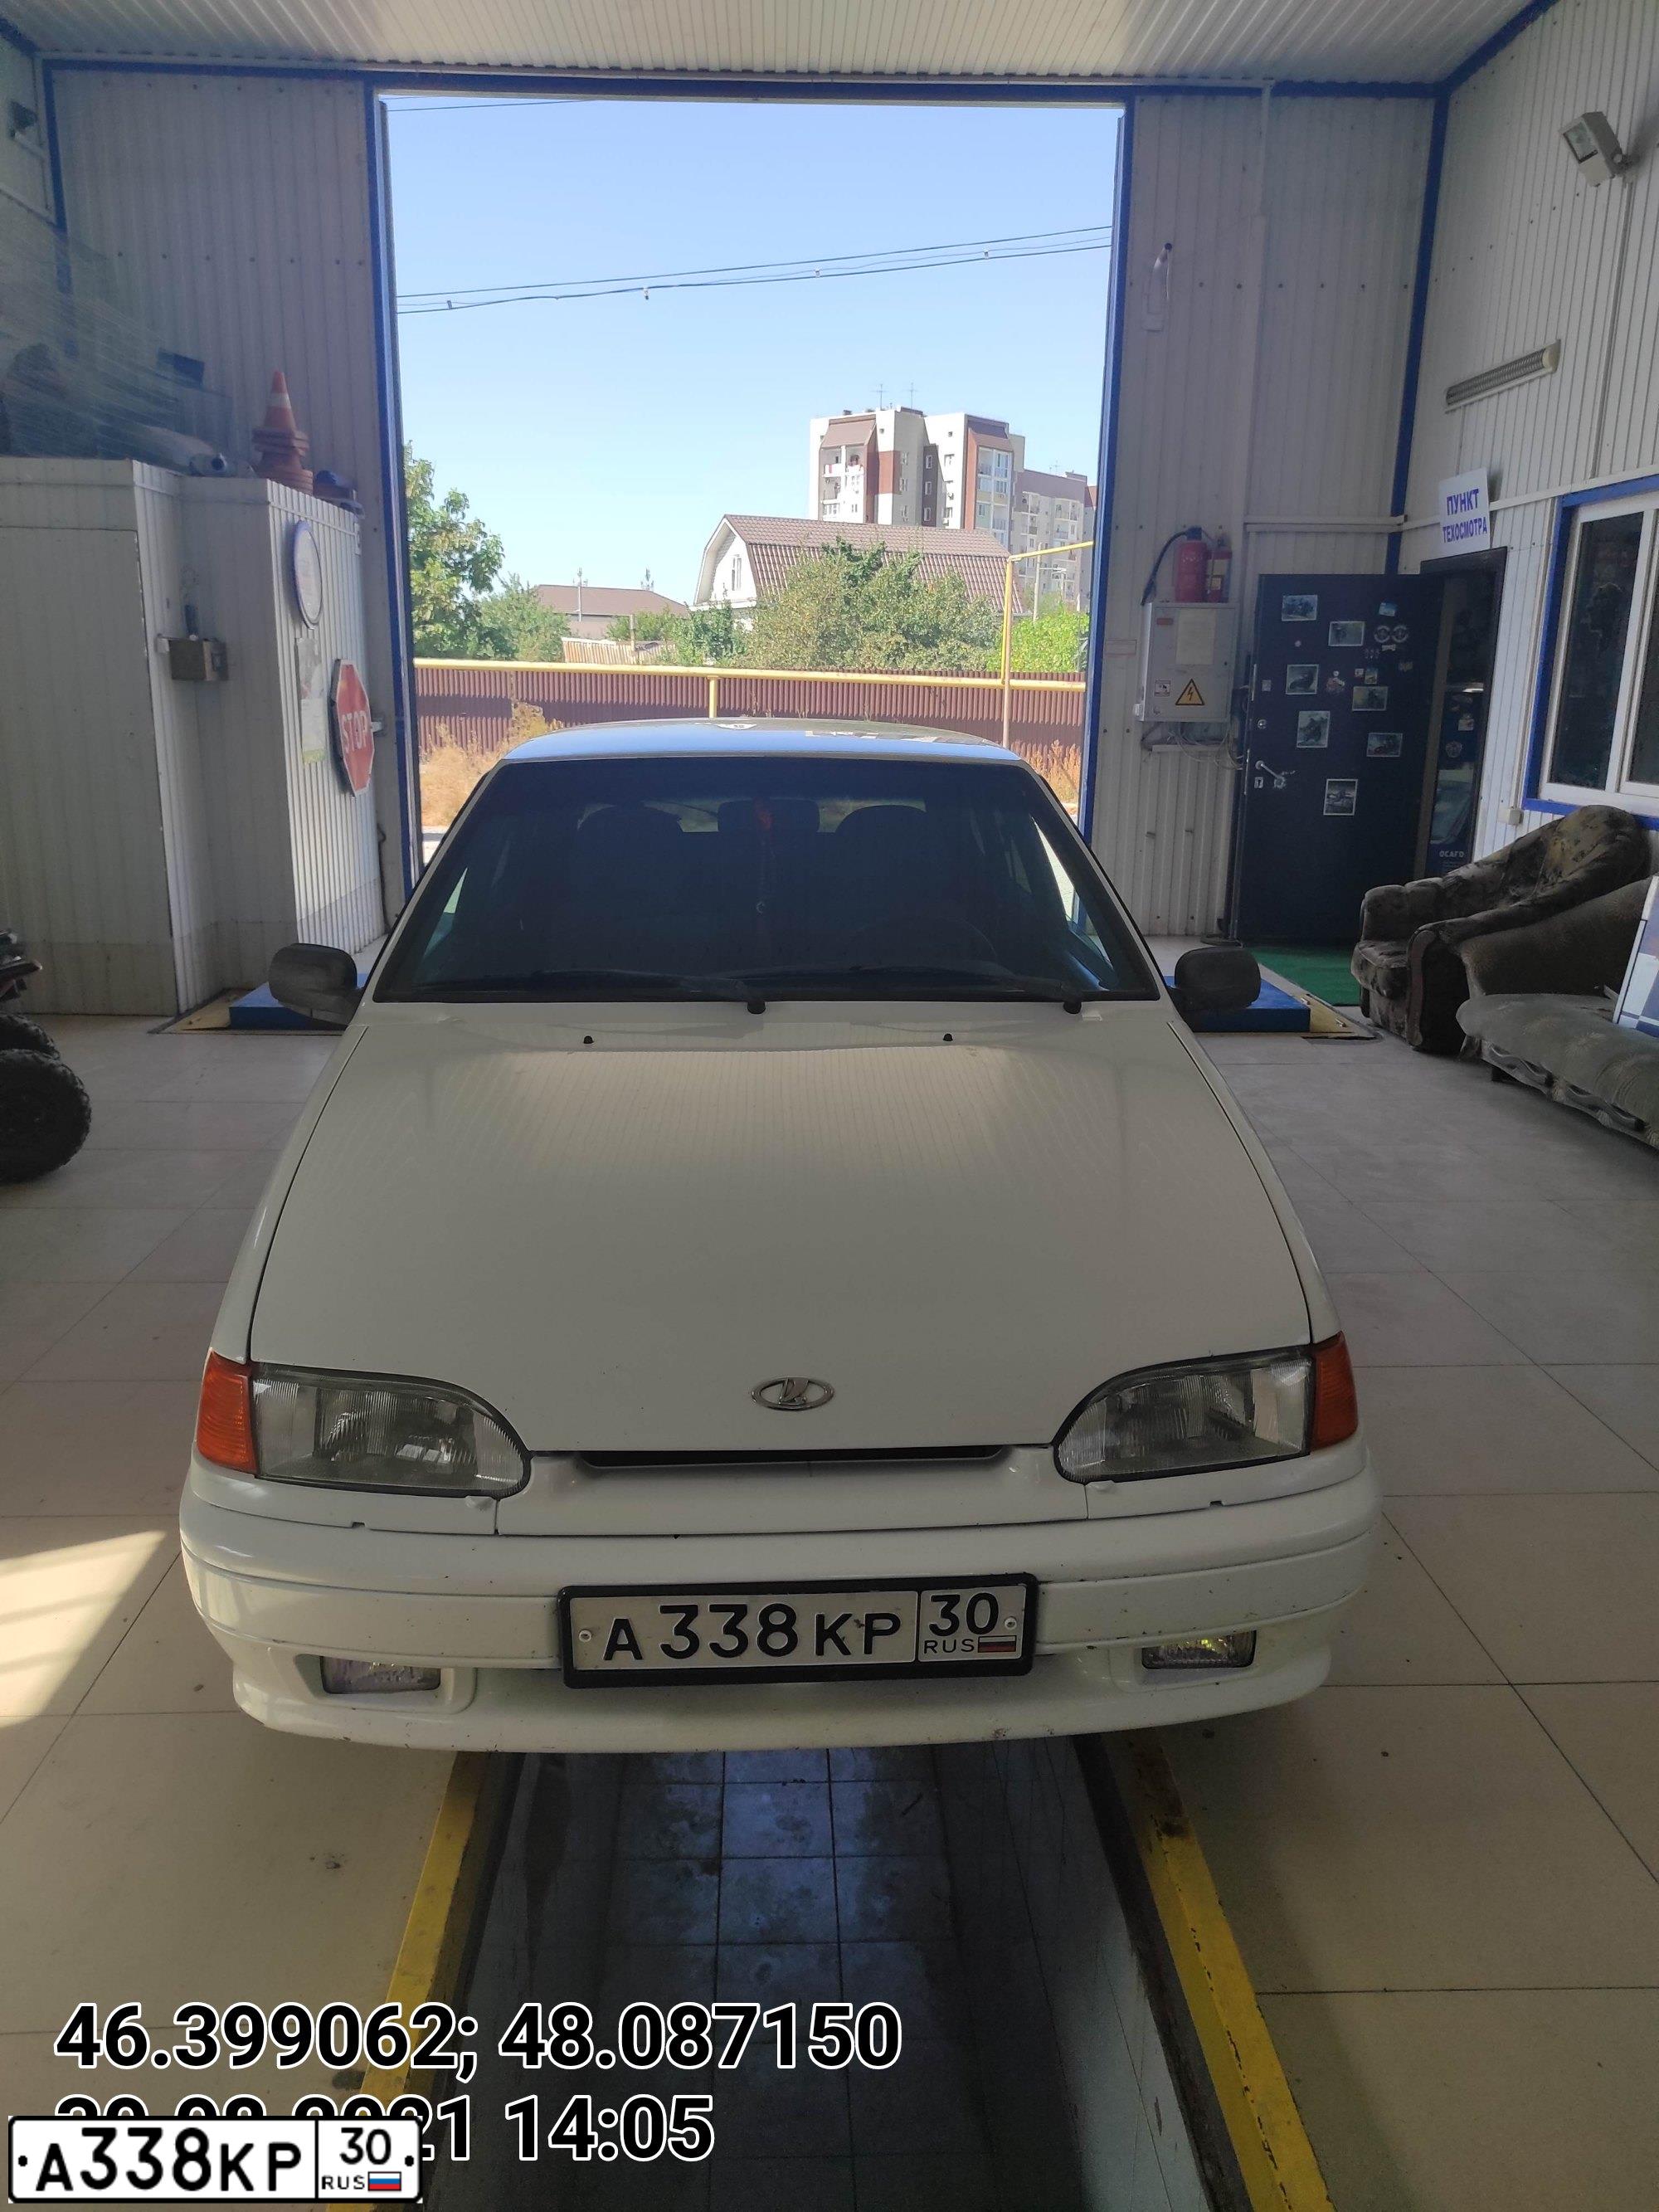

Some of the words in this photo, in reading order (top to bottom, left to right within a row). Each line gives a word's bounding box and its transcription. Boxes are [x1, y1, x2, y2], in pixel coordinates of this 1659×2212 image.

[1447, 489, 1479, 515] ПУНКТ
[1443, 517, 1487, 543] ТЕХОСМОТРА
[342, 710, 368, 754] STOP
[929, 1592, 1000, 1637] 30
[923, 1637, 975, 1654] RUS
